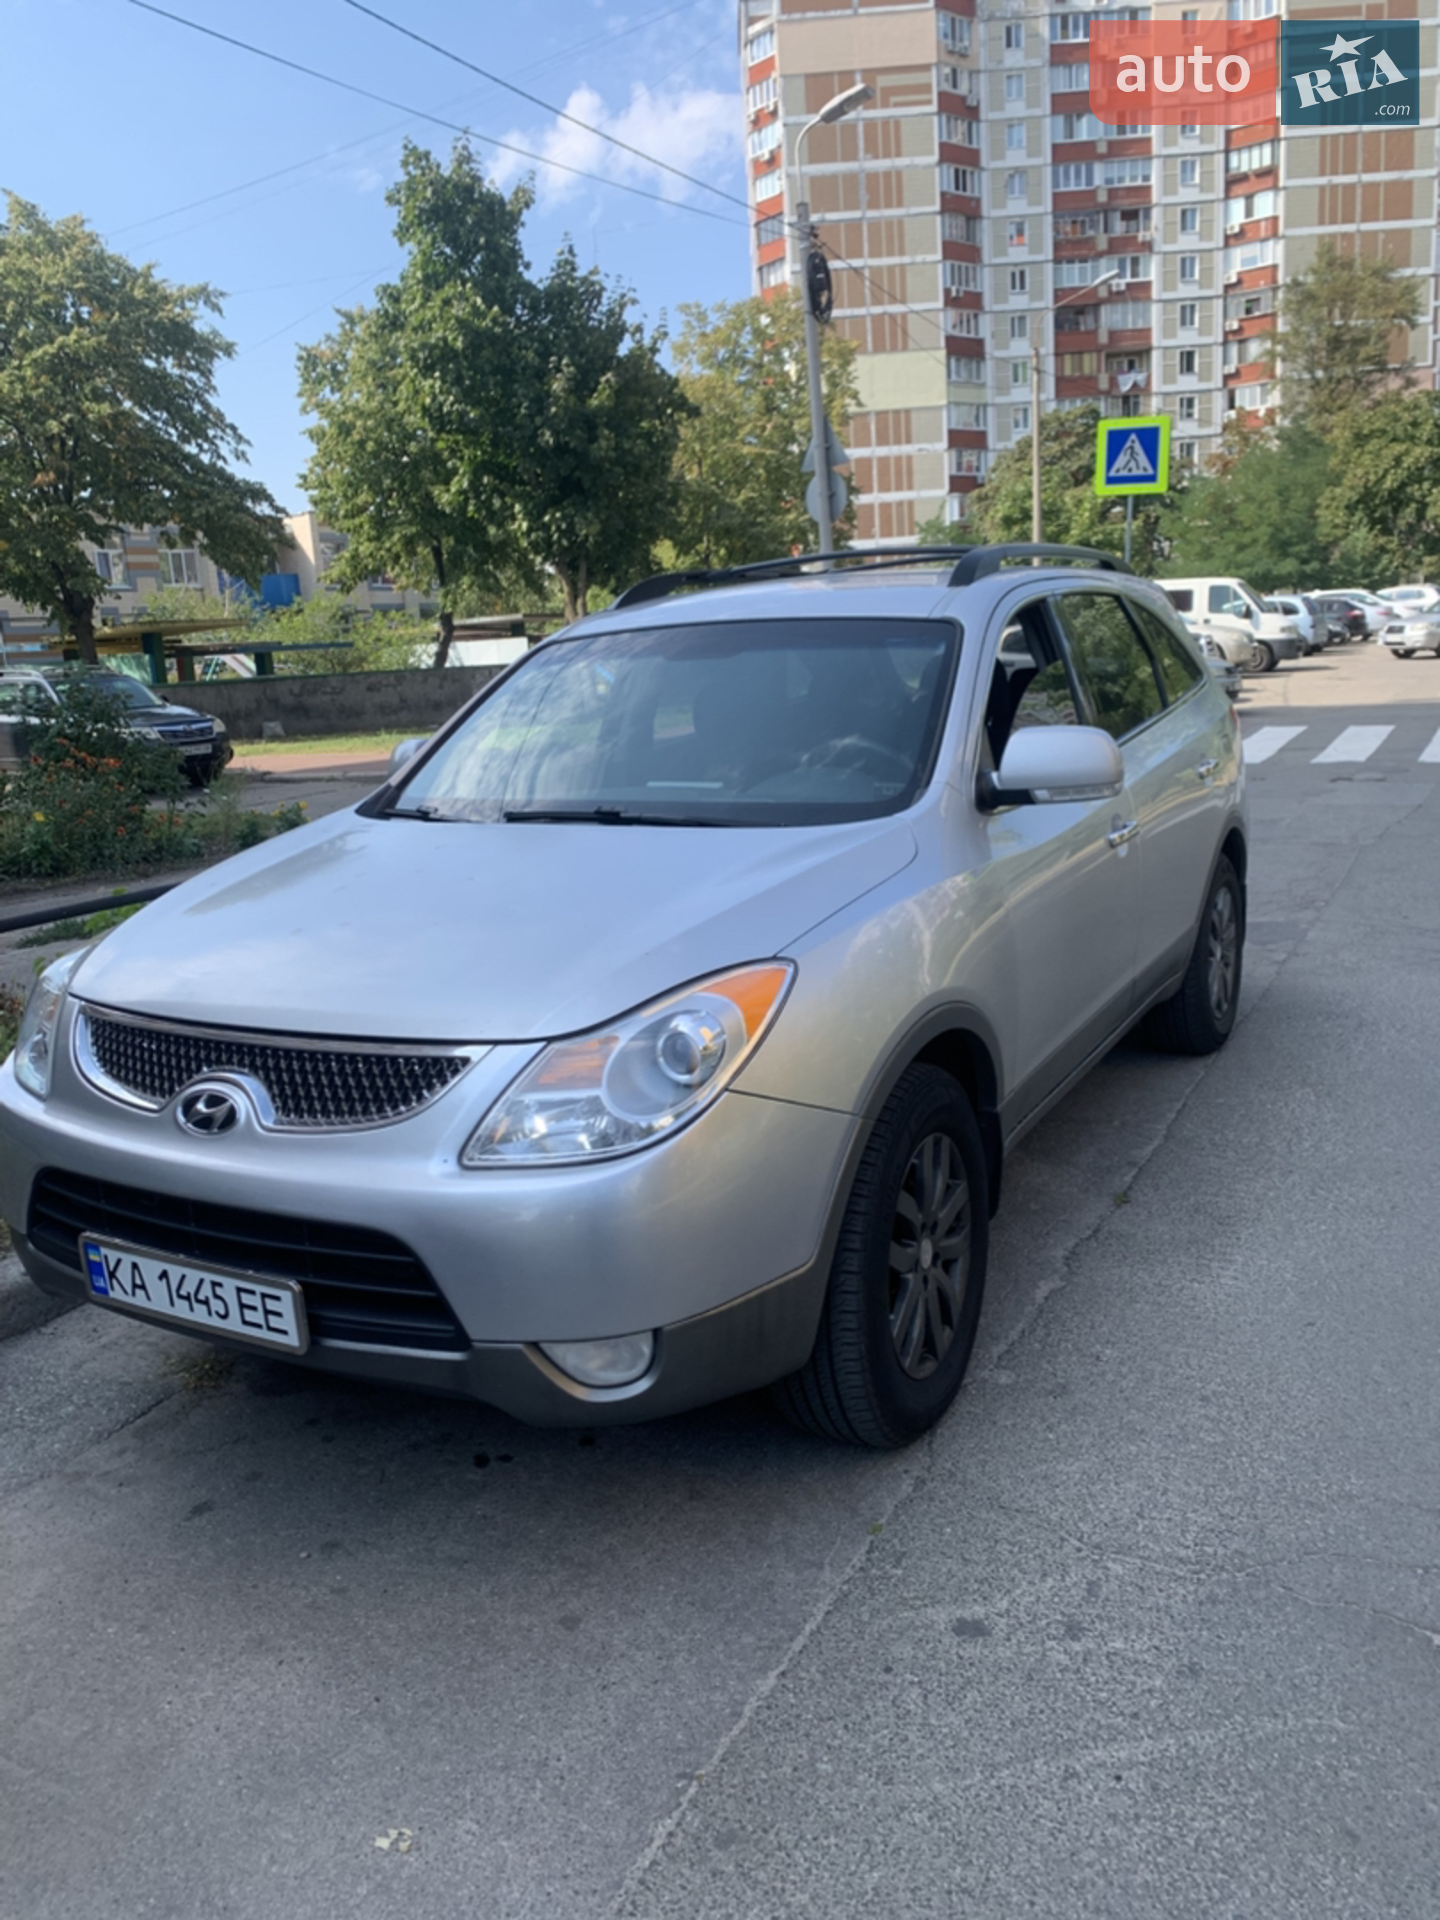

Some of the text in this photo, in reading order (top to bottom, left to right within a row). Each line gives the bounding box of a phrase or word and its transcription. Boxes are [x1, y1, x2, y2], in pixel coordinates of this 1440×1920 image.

[92, 1274, 107, 1289] UA
[103, 1253, 289, 1336] KA 1445 EE
